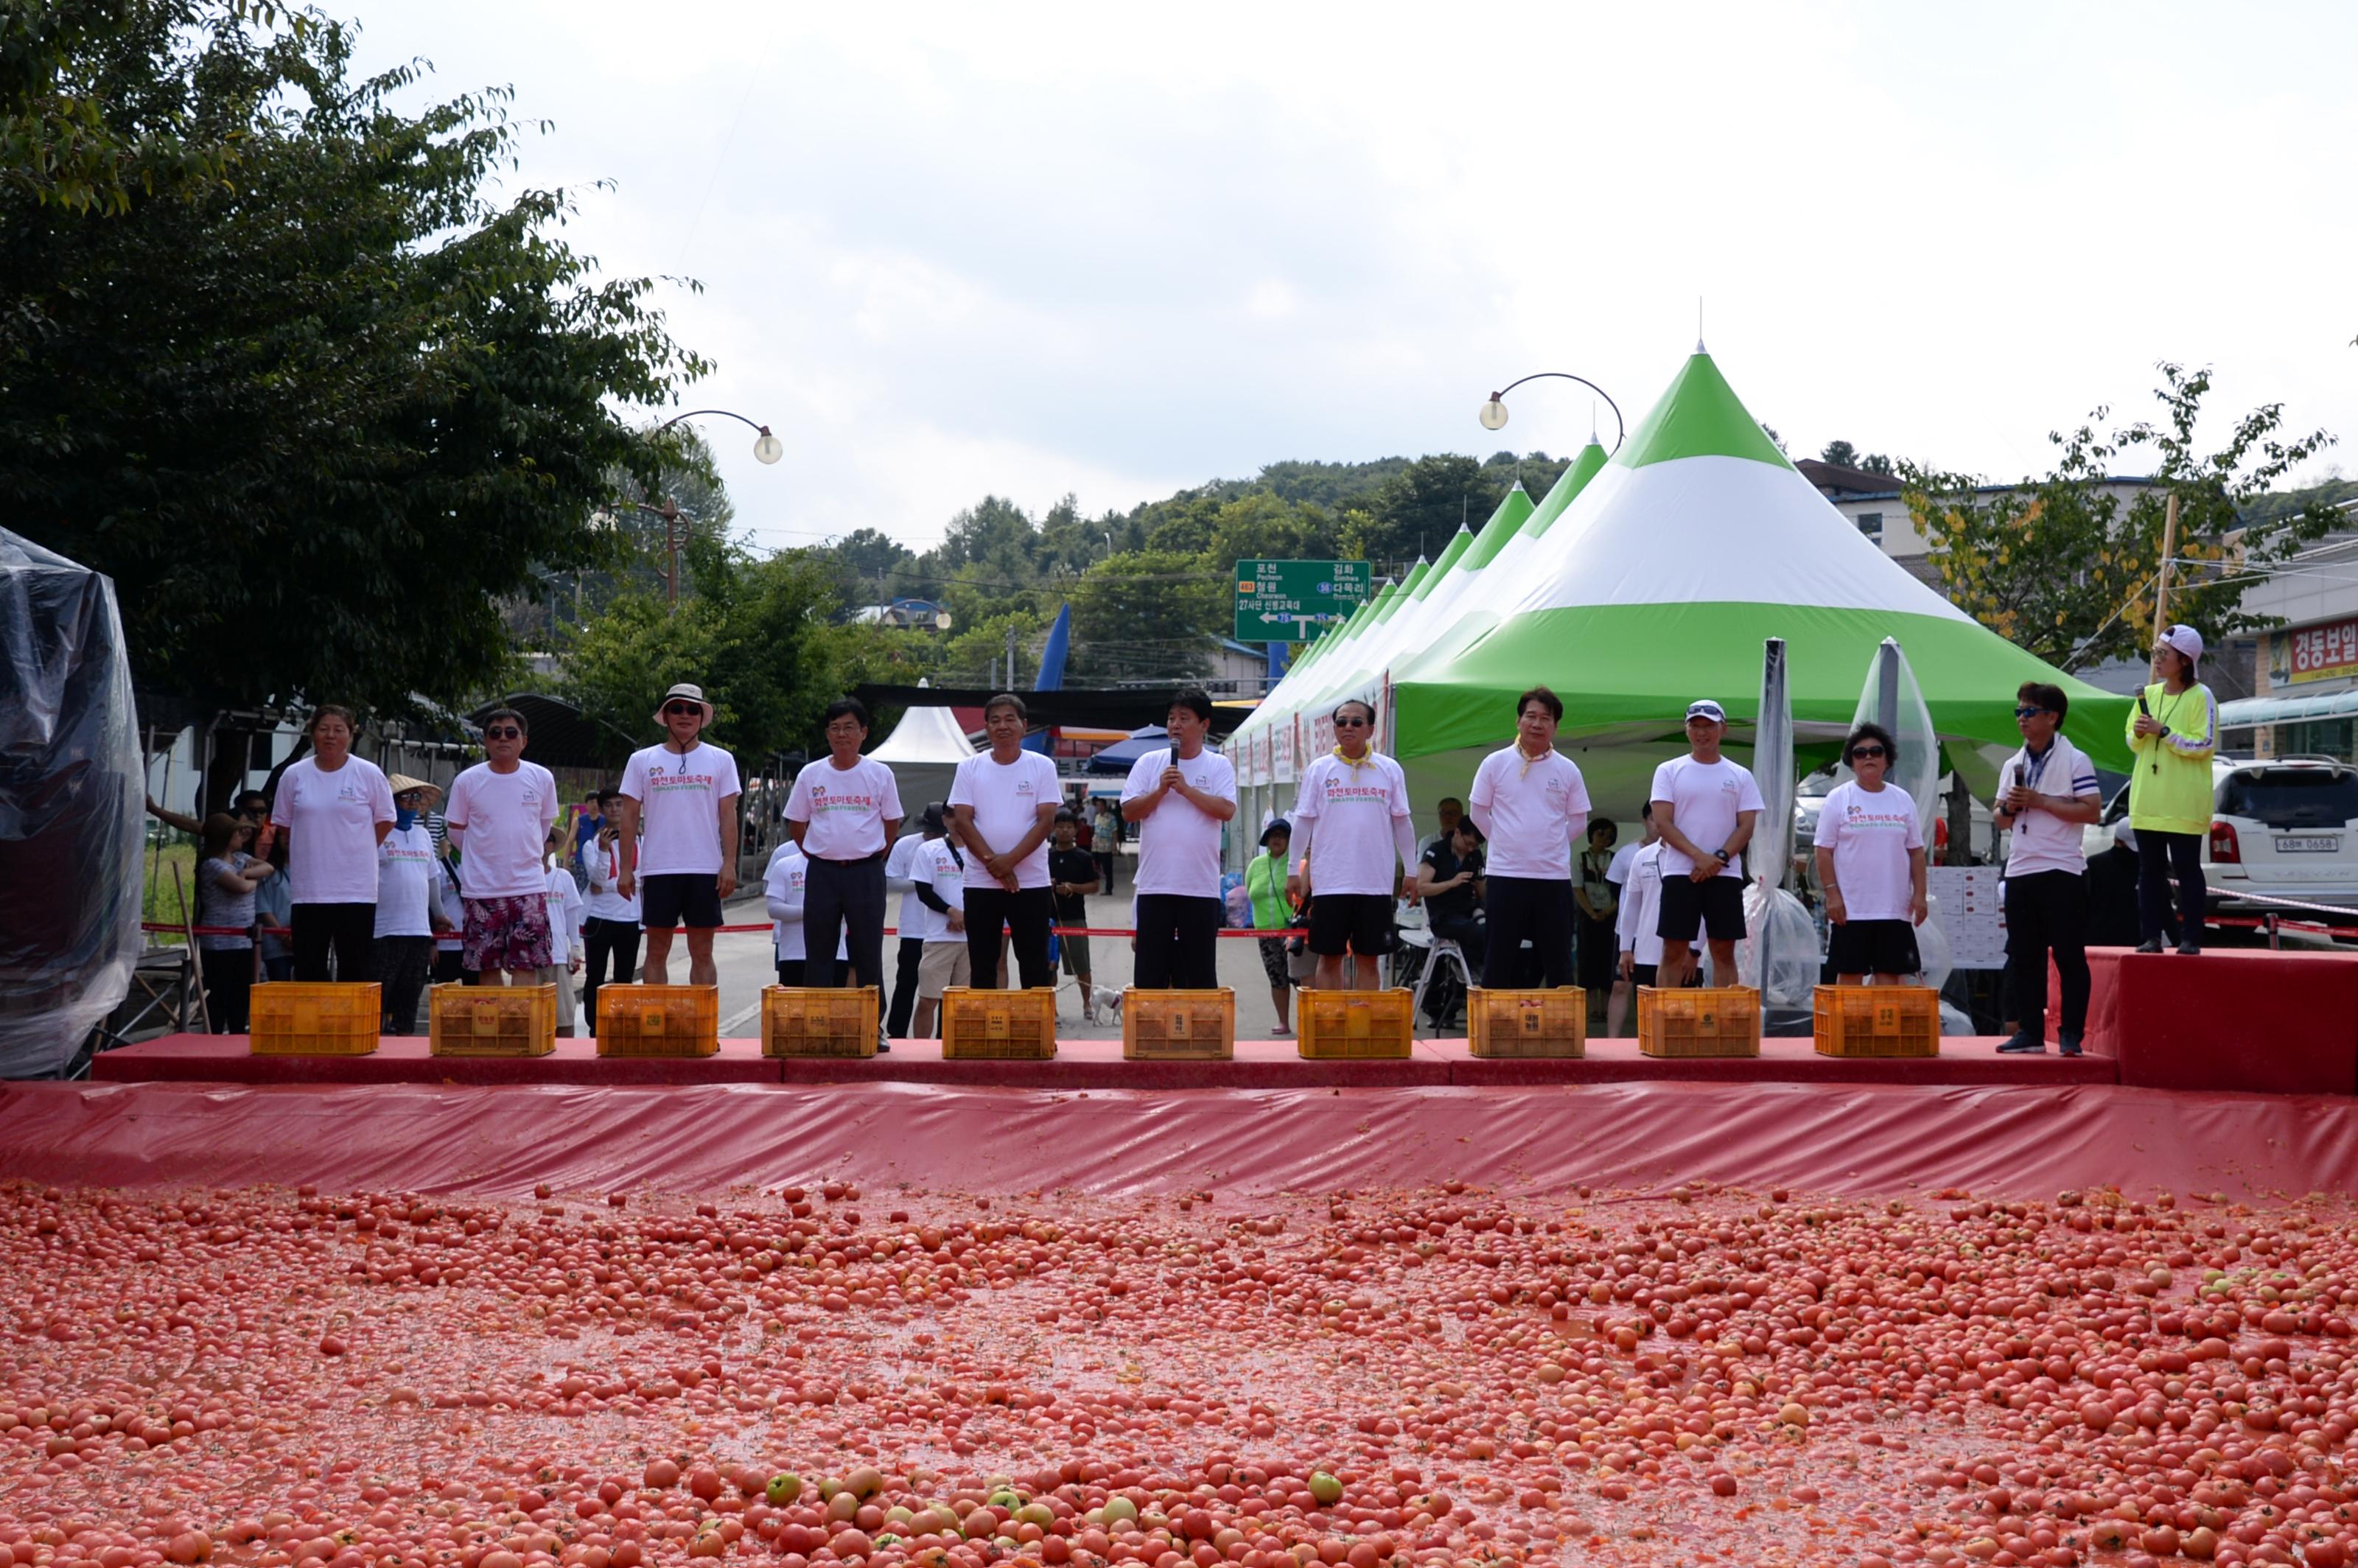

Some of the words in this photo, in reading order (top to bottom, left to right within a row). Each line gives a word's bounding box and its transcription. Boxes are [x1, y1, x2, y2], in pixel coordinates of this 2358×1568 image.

[1256, 563, 1276, 573] 포천
[1334, 564, 1354, 575] 김화
[1240, 583, 1253, 592] 463
[1256, 581, 1276, 592] 철원
[1333, 583, 1363, 593] 다목리
[1239, 600, 1262, 610] 27사단
[1264, 600, 1300, 611] 신병교육대
[651, 775, 712, 786] 화천토마토축제
[1327, 787, 1385, 797] 화천토마토축제
[814, 796, 871, 807] 화천토마토축제
[2306, 839, 2332, 848] 0658
